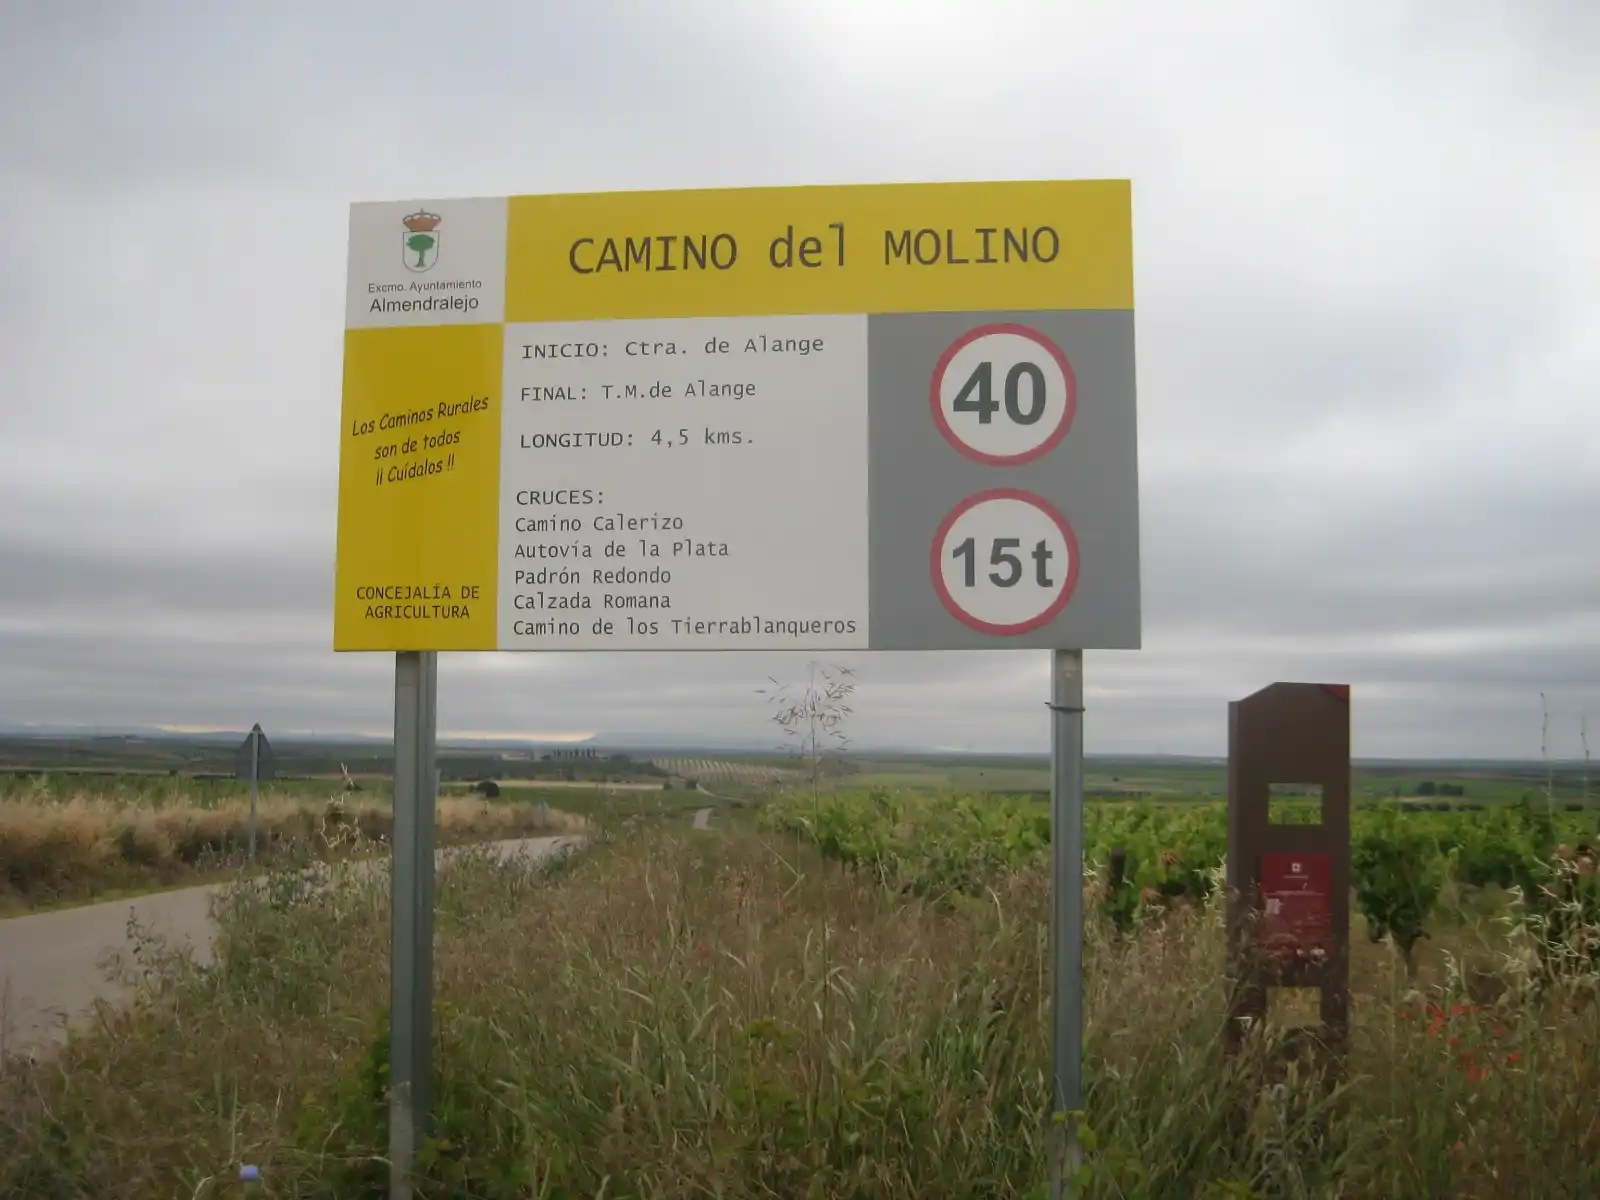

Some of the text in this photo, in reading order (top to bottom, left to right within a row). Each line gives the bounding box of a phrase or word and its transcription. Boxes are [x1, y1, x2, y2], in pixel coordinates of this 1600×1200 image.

[569, 222, 1060, 274] CAMINO del MOLINO
[368, 280, 482, 294] Excmo. Ayuntamiento
[370, 294, 479, 312] Almendralejo
[522, 335, 824, 359] INICIO: Ctra. de Alange
[521, 386, 588, 402] FINAL:
[684, 380, 756, 400] Alange
[953, 362, 1046, 426] 40
[352, 395, 489, 436] Los Caminos Rurales
[374, 430, 461, 460] son de todos
[520, 428, 754, 449] LONGITUD: 4,5 kms.
[388, 458, 442, 482] Cuídalos
[516, 490, 604, 506] CRUCES:
[516, 513, 684, 532] Camino Calerizo
[514, 538, 729, 559] Autovía de la Plata
[952, 537, 1054, 588] 15t
[514, 566, 672, 585] Padrón Redondo
[356, 585, 480, 600] CONCEJALÍA DE
[514, 592, 672, 610] Calzada Romana
[364, 605, 470, 620] AGRICULTURA
[513, 616, 857, 638] Camino de los Tierrablanqueros
